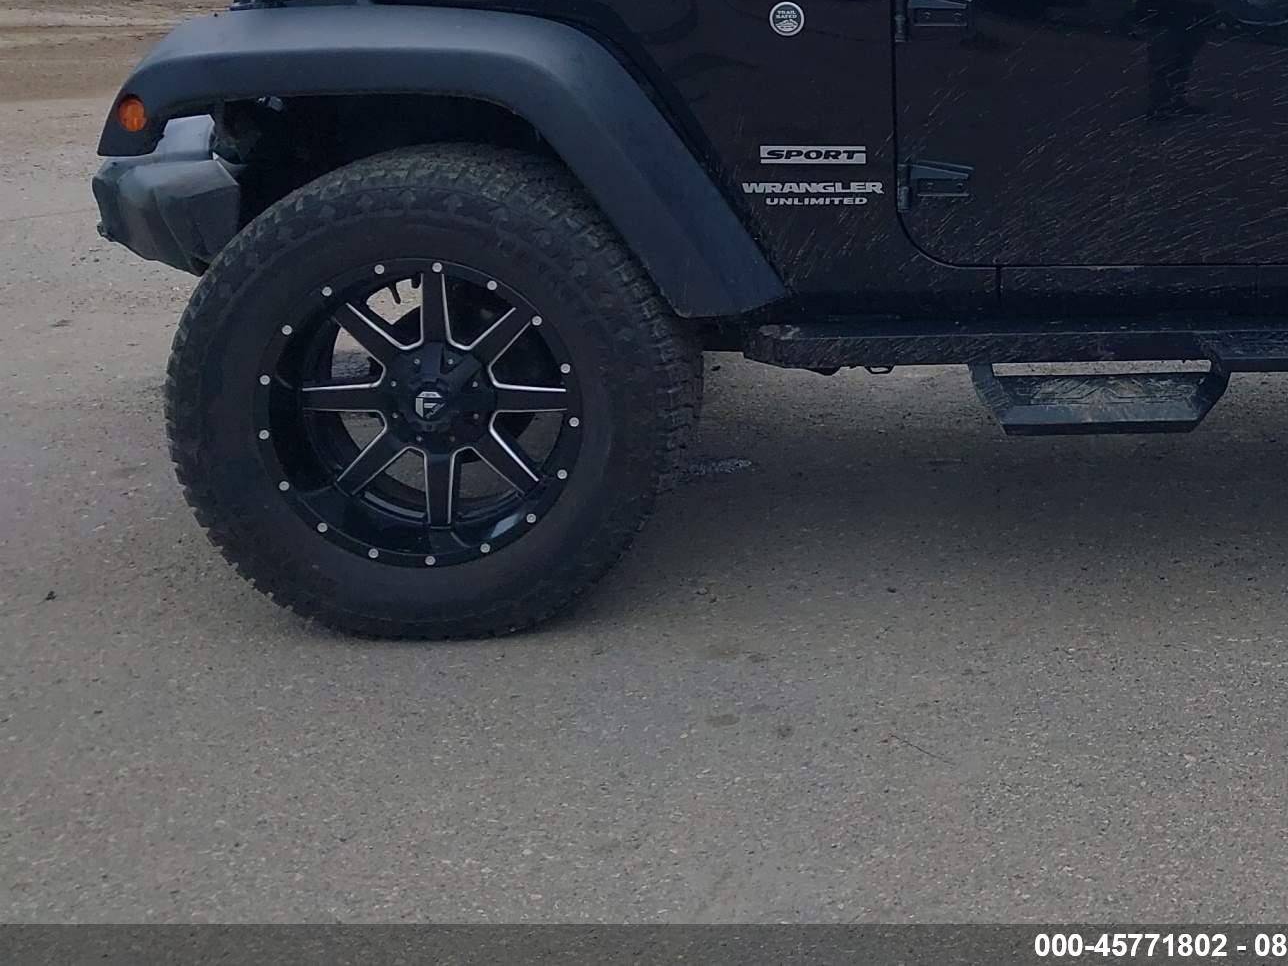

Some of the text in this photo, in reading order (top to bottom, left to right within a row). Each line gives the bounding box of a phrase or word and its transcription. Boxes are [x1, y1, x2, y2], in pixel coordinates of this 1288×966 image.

[761, 148, 866, 161] SPORT
[742, 182, 884, 194] WRANGLER
[765, 197, 868, 205] UNLIMITED
